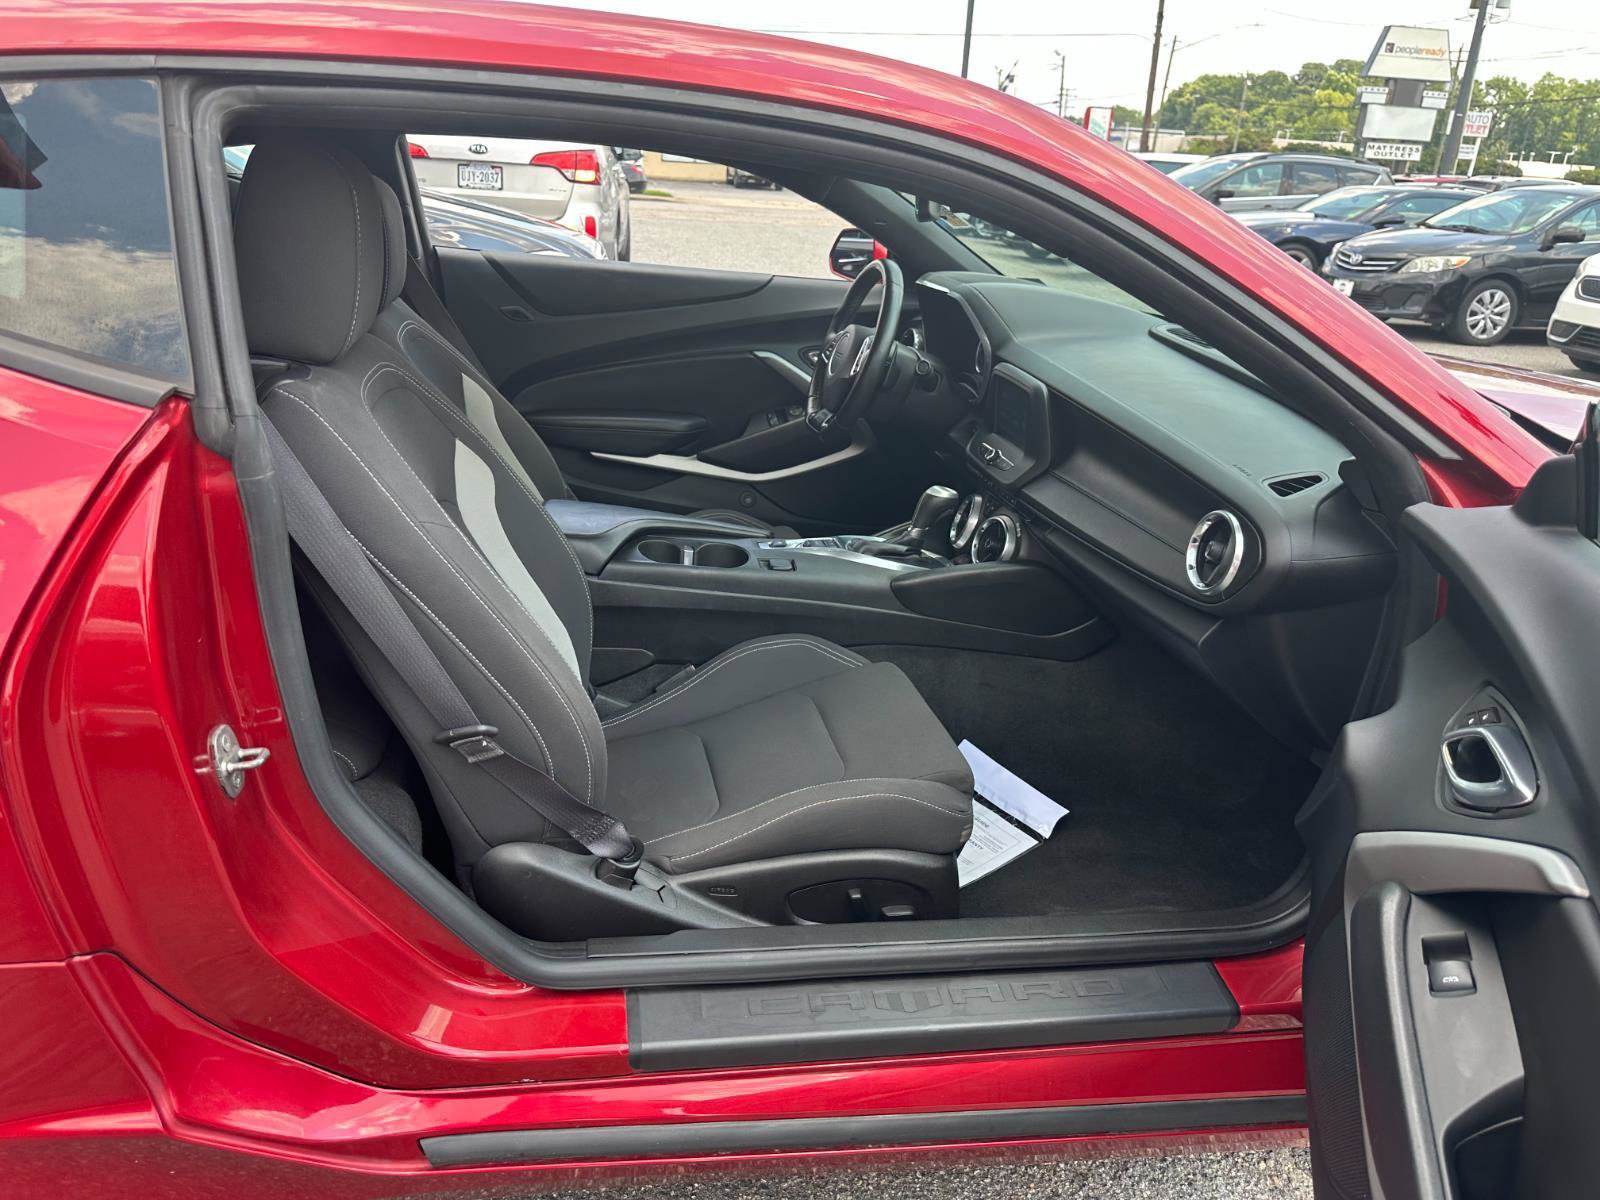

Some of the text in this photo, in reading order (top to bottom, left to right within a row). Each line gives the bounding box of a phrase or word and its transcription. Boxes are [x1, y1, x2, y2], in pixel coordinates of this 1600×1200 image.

[1395, 45, 1447, 57] peopleready
[1465, 114, 1490, 124] AUTO
[1464, 124, 1488, 134] TLET
[471, 145, 487, 153] KIA
[1367, 144, 1420, 153] MATTRESS
[1373, 150, 1412, 158] OUTLET
[748, 977, 1127, 1016] CAMARO
